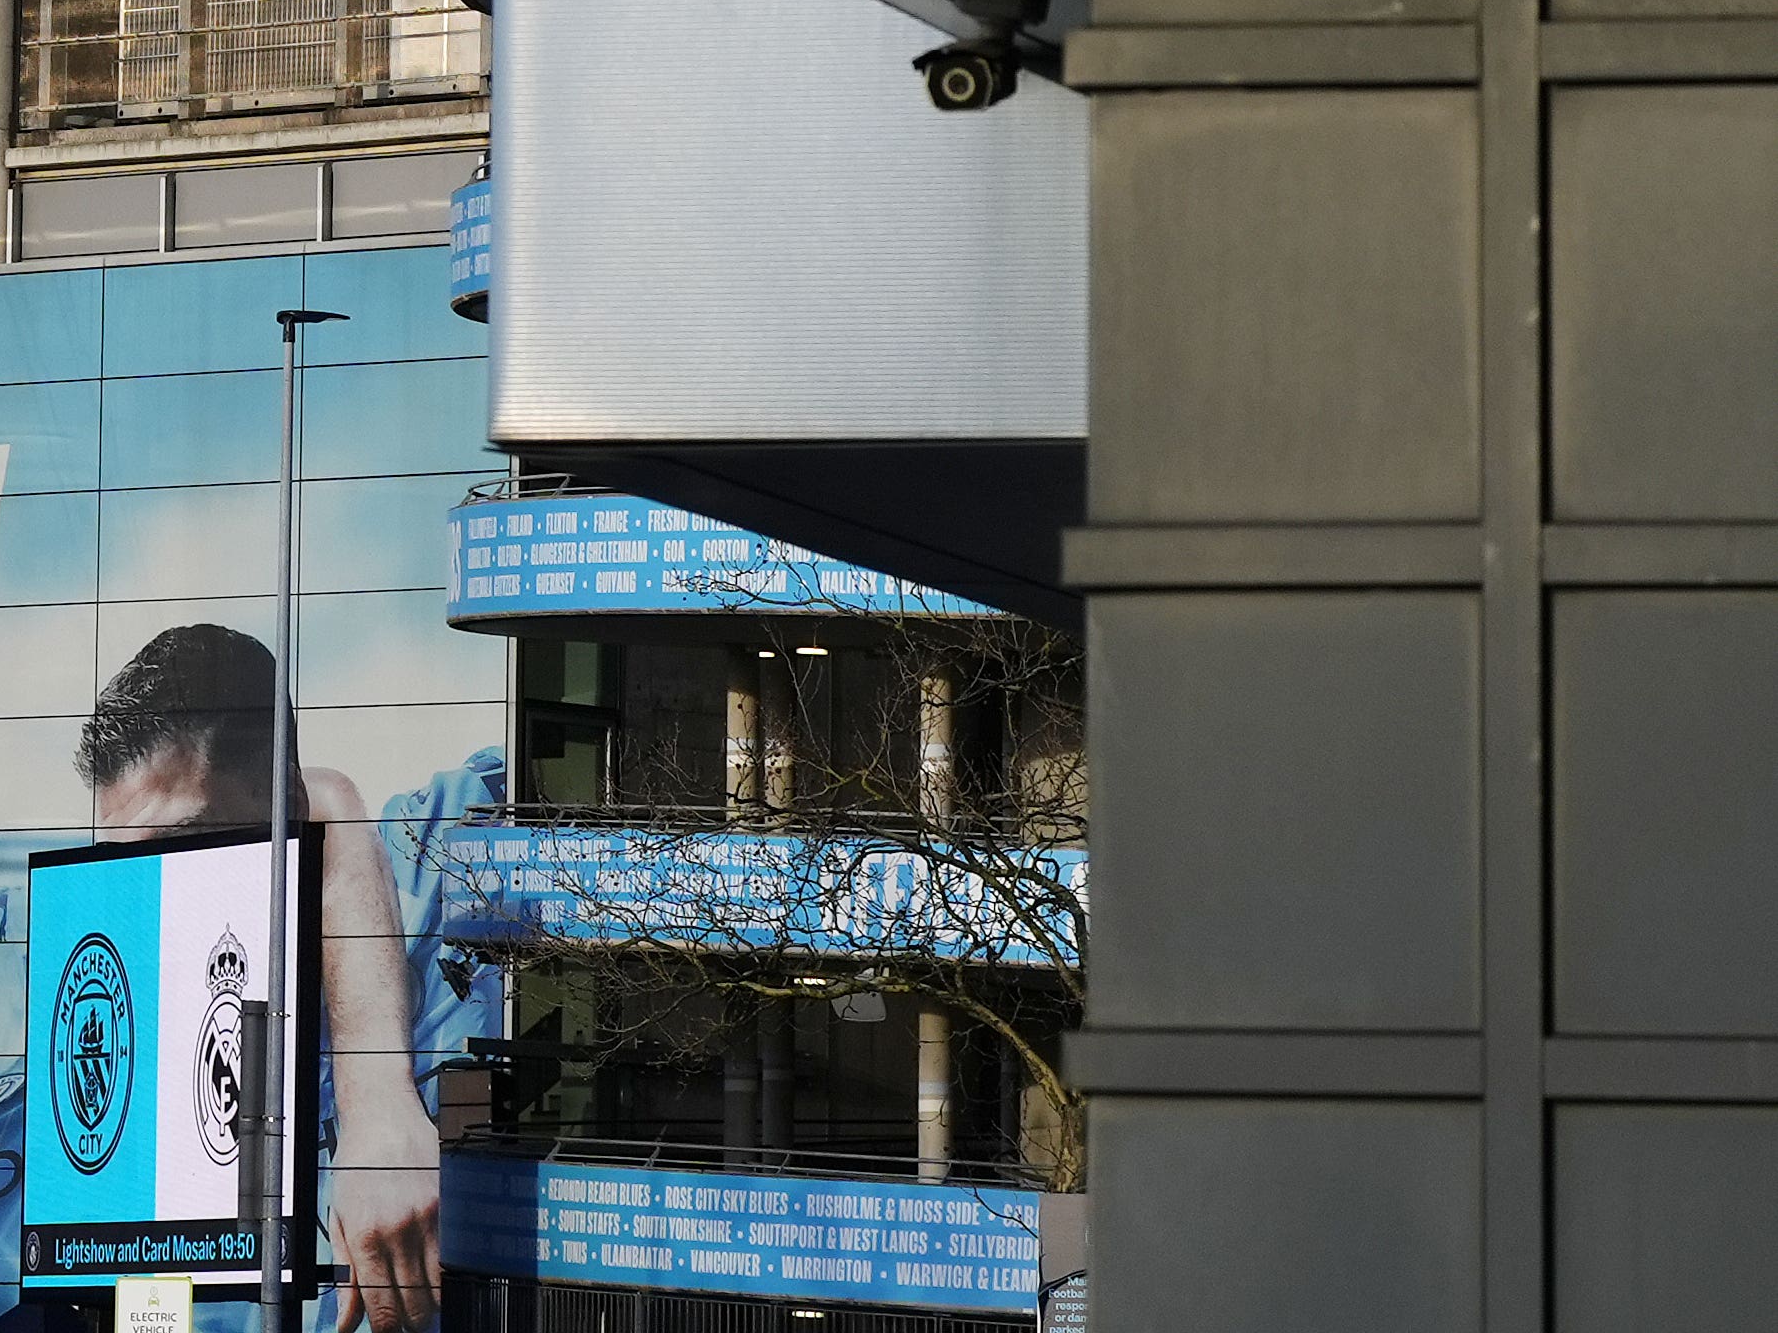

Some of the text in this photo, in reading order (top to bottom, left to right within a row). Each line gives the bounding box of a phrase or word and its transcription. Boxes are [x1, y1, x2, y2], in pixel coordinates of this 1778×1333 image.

[593, 510, 629, 534] FRANCE
[647, 509, 688, 532] FRESNO
[586, 540, 685, 563] CHELTENHAM GOA
[60, 951, 126, 1025] MANCHESTER
[78, 1133, 104, 1155] CITY
[548, 1178, 981, 1226] REDONDO BEACH BLUES ROSE CITY SKY BLUES RUSHOLME & MOSS SIDE
[558, 1209, 586, 1233] SOUTH
[587, 1211, 621, 1236] STAFFS
[633, 1215, 666, 1239] SOUTH
[669, 1217, 733, 1244] YORKSHIRE
[748, 1224, 825, 1249] SOUTHPORT
[826, 1227, 836, 1248] &
[839, 1227, 879, 1252] WEST
[881, 1229, 928, 1255] LANCS
[55, 1233, 255, 1269] Lightshow and Card Mosaic 19:50
[601, 1243, 989, 1290] ULAANBAATAR VANCOUVER WARRINGTON WARWICK &
[129, 1312, 178, 1323] ELECTRIC
